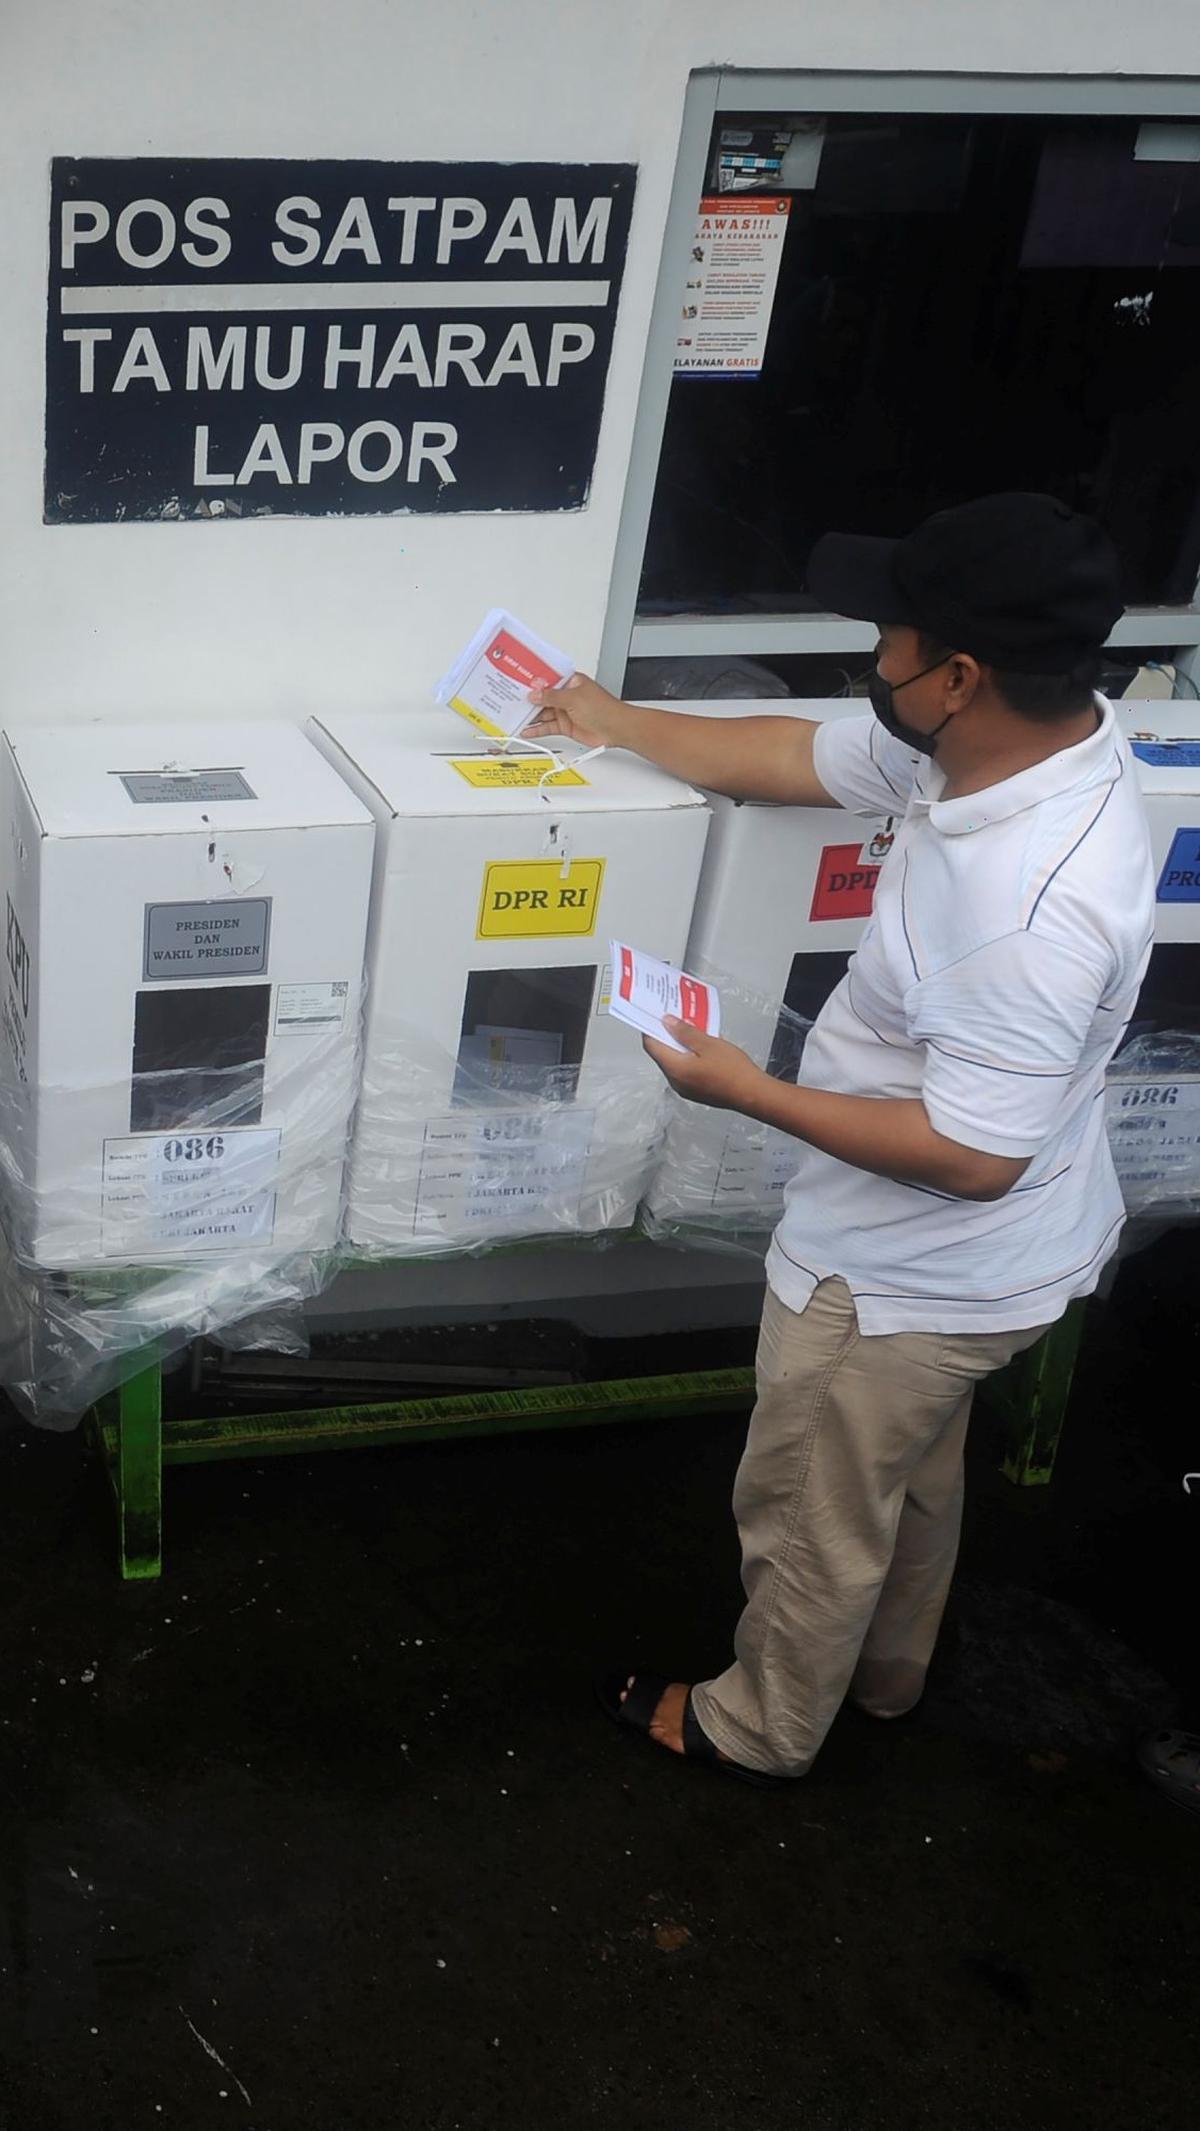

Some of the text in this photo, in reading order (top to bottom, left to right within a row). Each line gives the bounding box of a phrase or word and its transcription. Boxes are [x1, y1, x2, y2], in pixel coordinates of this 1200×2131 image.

[60, 196, 612, 269] POS SATPAM
[702, 219, 770, 230] AWAS!!!
[63, 323, 596, 393] TAMU HARAP
[727, 358, 759, 367] GRATIS
[194, 420, 458, 486] LAPOR
[492, 888, 589, 910] DPR RI
[176, 919, 240, 931] PRESIDEN
[194, 934, 220, 944] DAN
[153, 945, 260, 961] WAKIL PRESIDEN
[164, 1136, 225, 1162] 086
